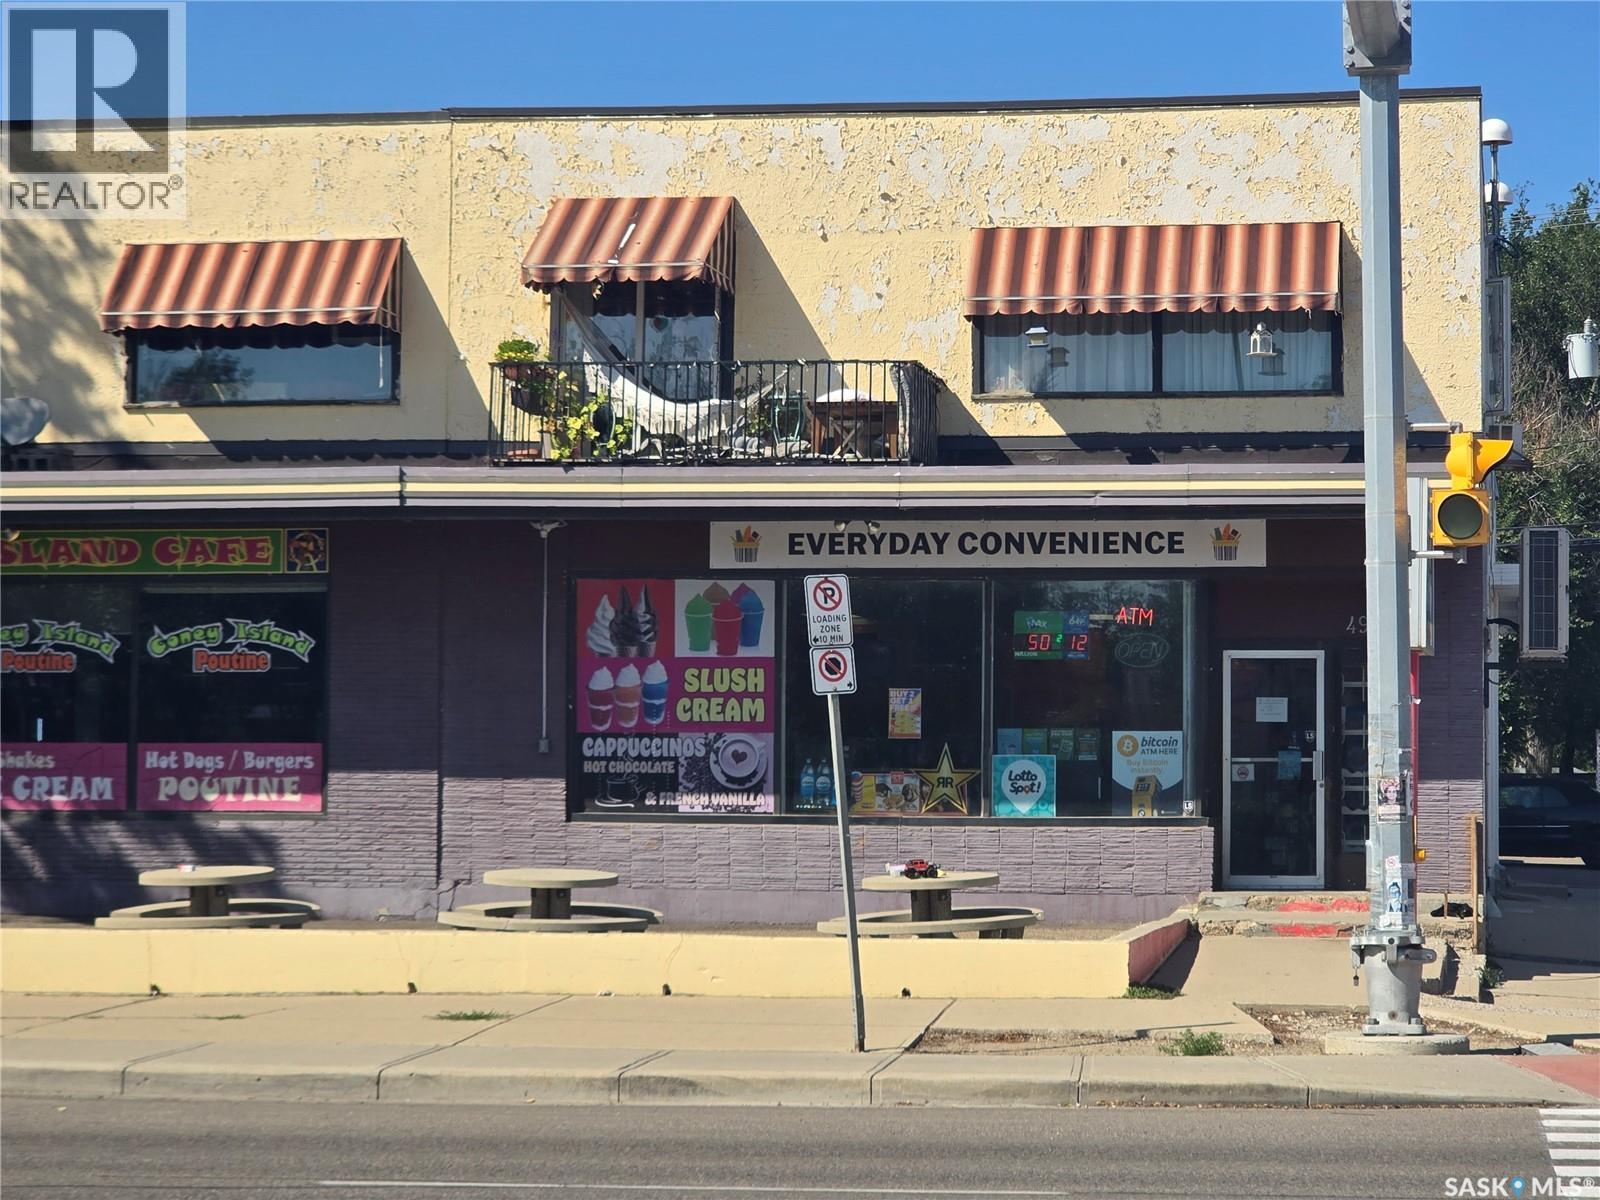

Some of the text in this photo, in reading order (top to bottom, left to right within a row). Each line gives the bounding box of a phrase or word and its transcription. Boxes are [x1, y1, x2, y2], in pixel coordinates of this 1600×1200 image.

[153, 535, 275, 569] CAFE
[788, 530, 1185, 556] EVERYDAY CONVENIENCE
[812, 614, 847, 623] LOADING
[1116, 606, 1154, 626] ATM
[819, 634, 844, 643] 10 MIN
[820, 625, 841, 633] ZONE
[1056, 634, 1063, 643] 2
[31, 619, 121, 663] Island
[147, 618, 316, 663] Coney Island
[1028, 634, 1051, 651] 50
[1071, 634, 1088, 651] 12
[1117, 640, 1163, 659] OPEN
[0, 648, 77, 673] Poutine
[193, 648, 271, 673] Poutine
[683, 667, 766, 693] SLUSH
[675, 697, 766, 722] CREAM
[582, 737, 706, 758] CAPPUCCINOS
[1141, 736, 1179, 747] bitcoin
[145, 751, 178, 769] Hot
[183, 751, 225, 773] Dogs
[243, 751, 314, 773] Burgers
[583, 760, 675, 773] HOT CHOCOLATE
[1008, 770, 1038, 782] Lotto
[12, 775, 114, 802] CREAM
[158, 776, 301, 802] POUTINE
[1009, 782, 1041, 795] Spot!
[645, 792, 765, 806] & FRENCH VANILLA
